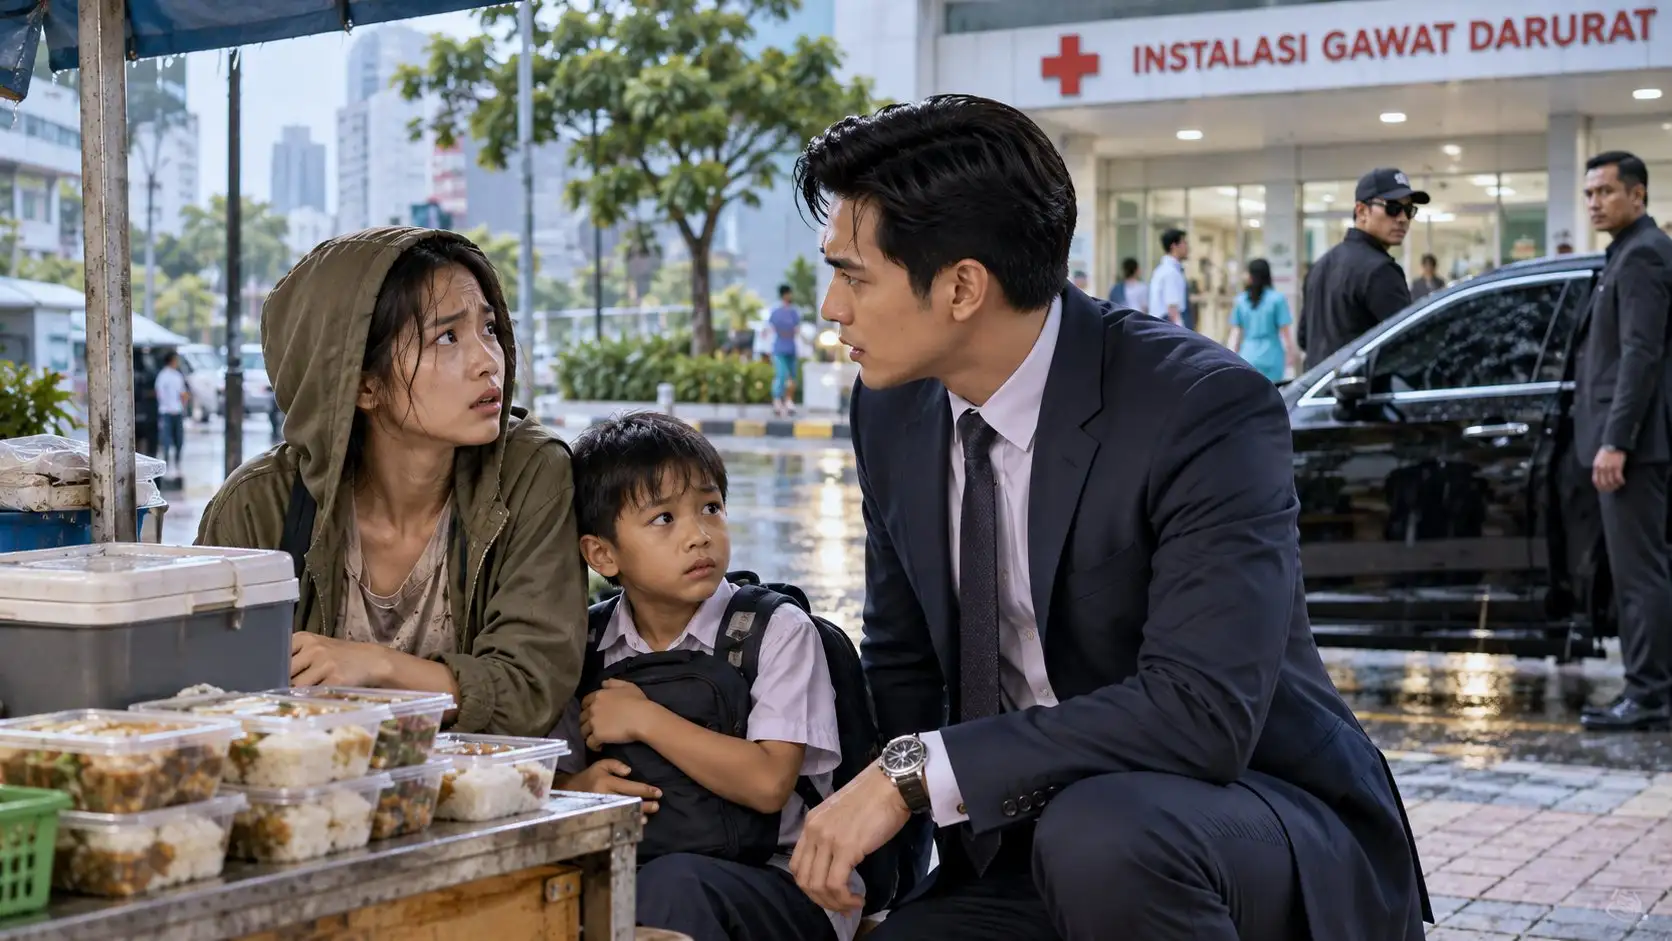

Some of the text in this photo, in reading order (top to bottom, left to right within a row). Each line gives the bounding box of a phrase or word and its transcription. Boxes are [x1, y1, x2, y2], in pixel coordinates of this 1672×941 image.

[1133, 8, 1657, 74] INSTALASI GAWAT DARURAT
